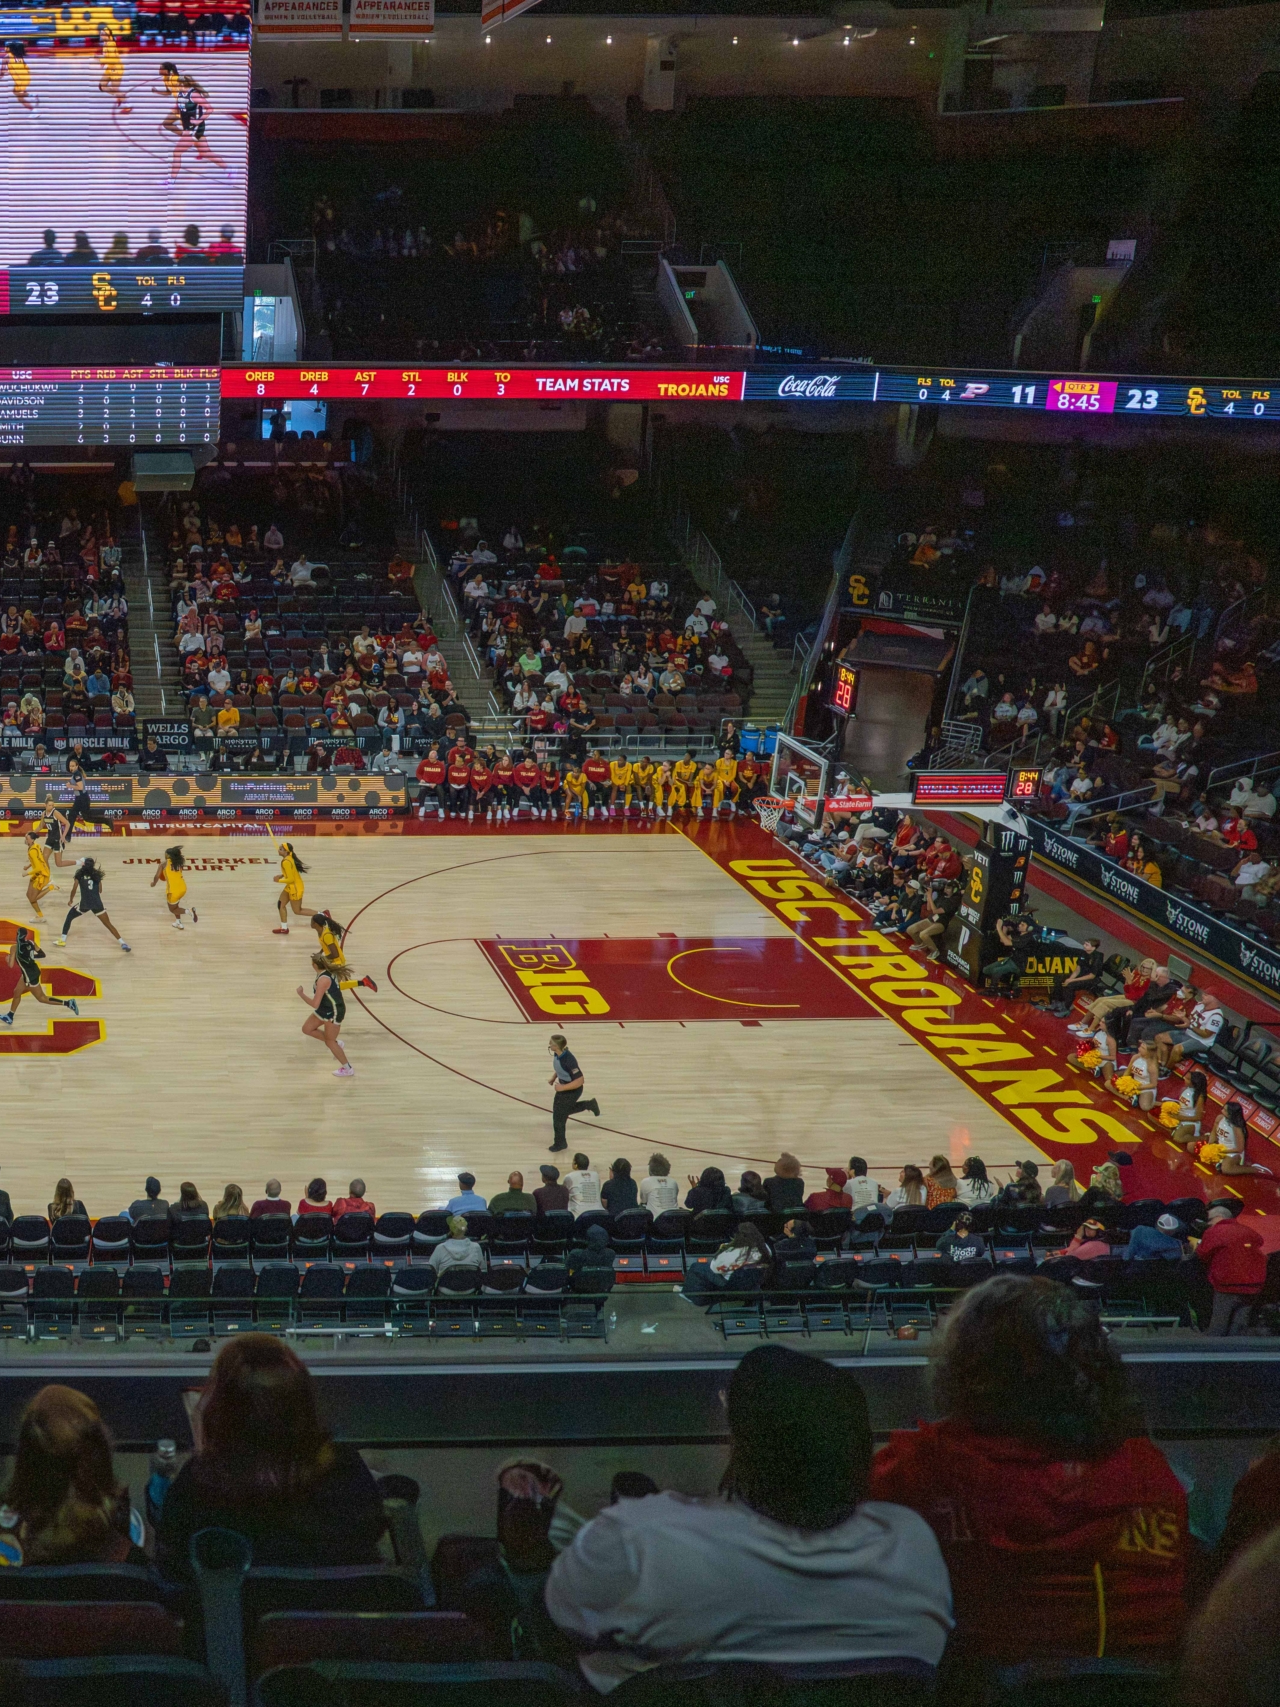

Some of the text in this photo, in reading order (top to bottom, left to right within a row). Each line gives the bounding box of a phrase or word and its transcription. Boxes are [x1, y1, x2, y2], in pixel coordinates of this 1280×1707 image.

[25, 282, 59, 306] 23
[141, 292, 152, 307] 4
[245, 371, 511, 382] OREB DREB AST STL BLK TO
[917, 378, 956, 388] FLS TOL
[256, 384, 505, 397] 8 4 7 2 0 3
[536, 378, 630, 393] TEAM STATS
[657, 383, 729, 398] TROJANS
[919, 388, 951, 402] 0 4
[1012, 386, 1036, 404] 11
[1126, 390, 1158, 410] 23
[1222, 390, 1270, 400] TOL FLS
[1057, 393, 1101, 412] 8:45
[1223, 402, 1264, 416] 4 0
[840, 668, 855, 685] 8:44
[836, 681, 852, 708] 28
[147, 724, 188, 733] WELLS
[11, 738, 34, 748] MILK
[69, 738, 130, 748] MUSCLE MILK
[154, 736, 188, 744] ARGO
[1020, 771, 1039, 782] 8:44
[1016, 782, 1033, 795] 28
[974, 850, 989, 867] YETI
[1052, 842, 1080, 864] STONE
[88, 880, 94, 890] 3
[1110, 876, 1140, 900] STONE
[1176, 913, 1210, 938] STONE
[948, 950, 970, 970] PECHANGA
[1252, 954, 1280, 978] STON
[728, 858, 1143, 1144] USC TROJANS
[1210, 1019, 1220, 1027] 55
[1210, 1087, 1227, 1100] FARGO
[1214, 1080, 1231, 1094] WELLS
[1254, 1116, 1272, 1130] FARGO
[1258, 1110, 1275, 1125] WELLS
